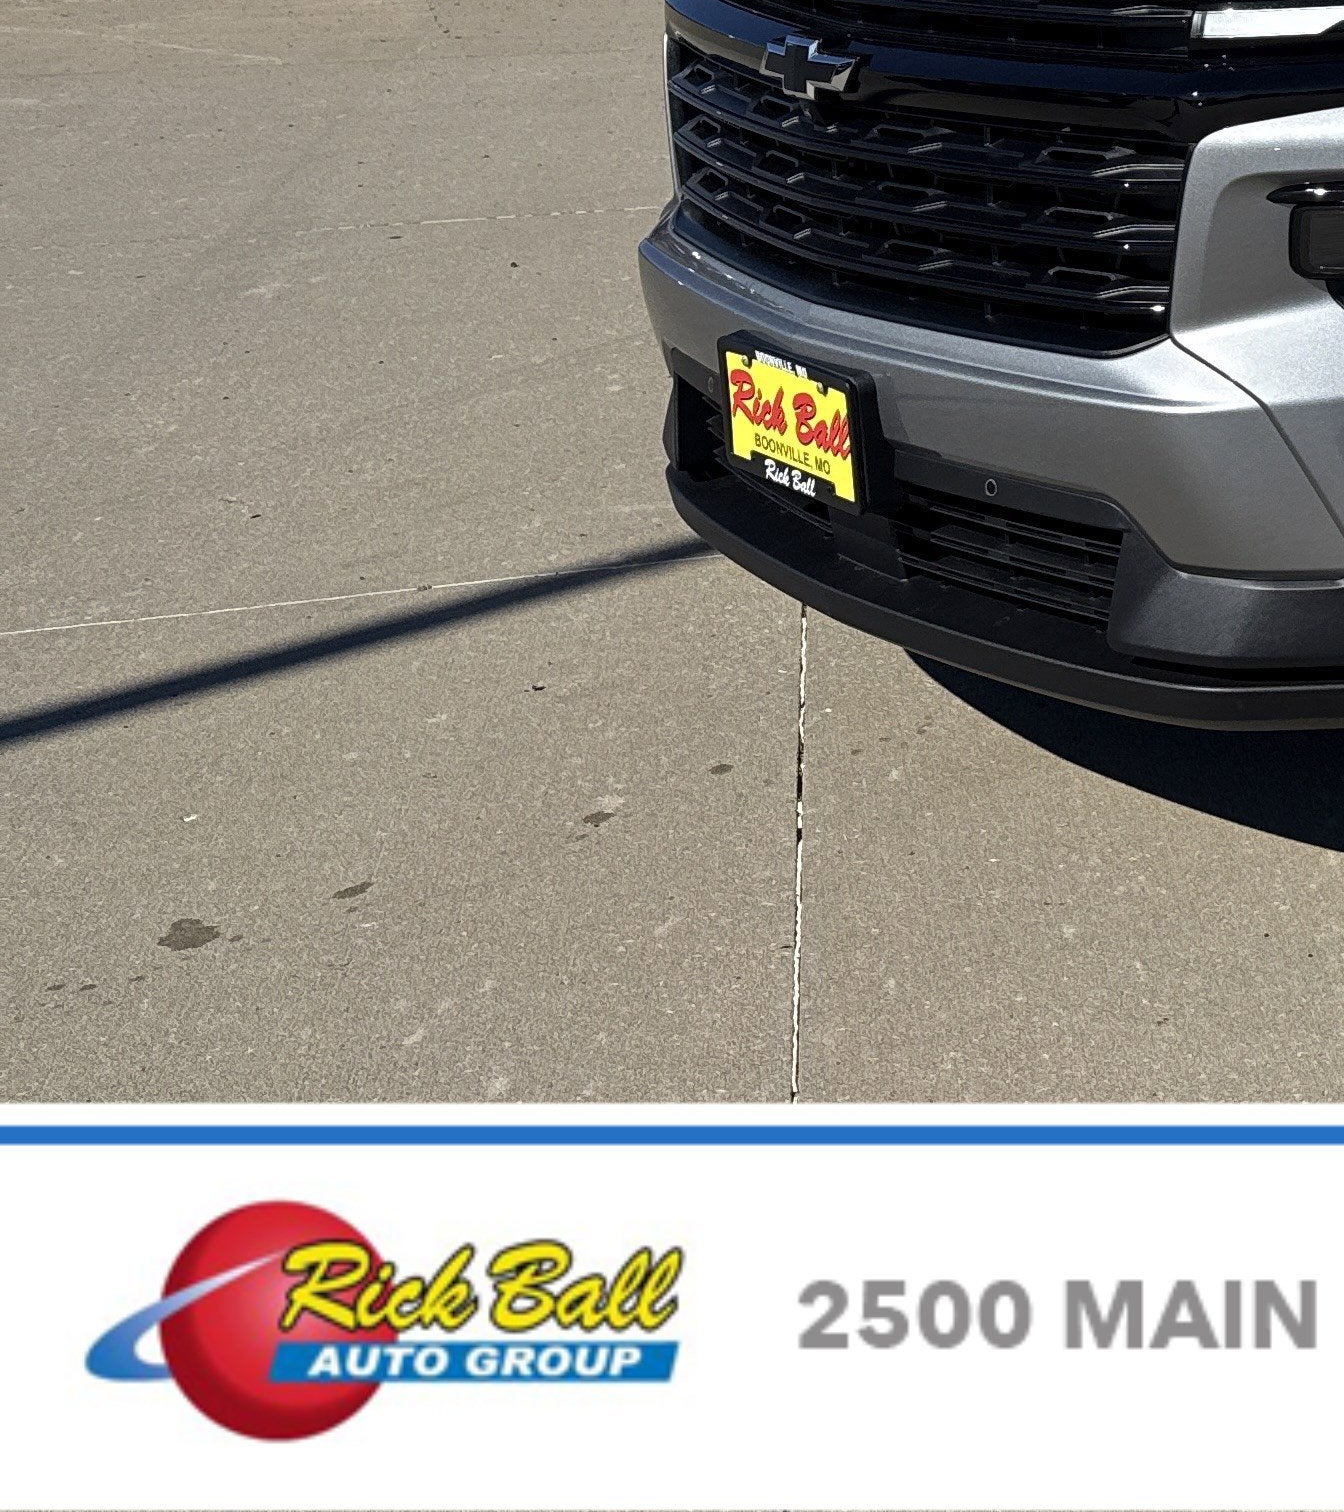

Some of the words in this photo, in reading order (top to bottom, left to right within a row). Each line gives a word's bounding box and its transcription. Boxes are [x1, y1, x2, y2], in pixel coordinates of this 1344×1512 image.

[730, 368, 788, 436] Rick
[792, 392, 851, 460] Ball
[754, 432, 813, 470] BOONVILLE,
[814, 455, 831, 475] MO
[764, 458, 790, 487] Rick
[791, 469, 817, 498] Ball
